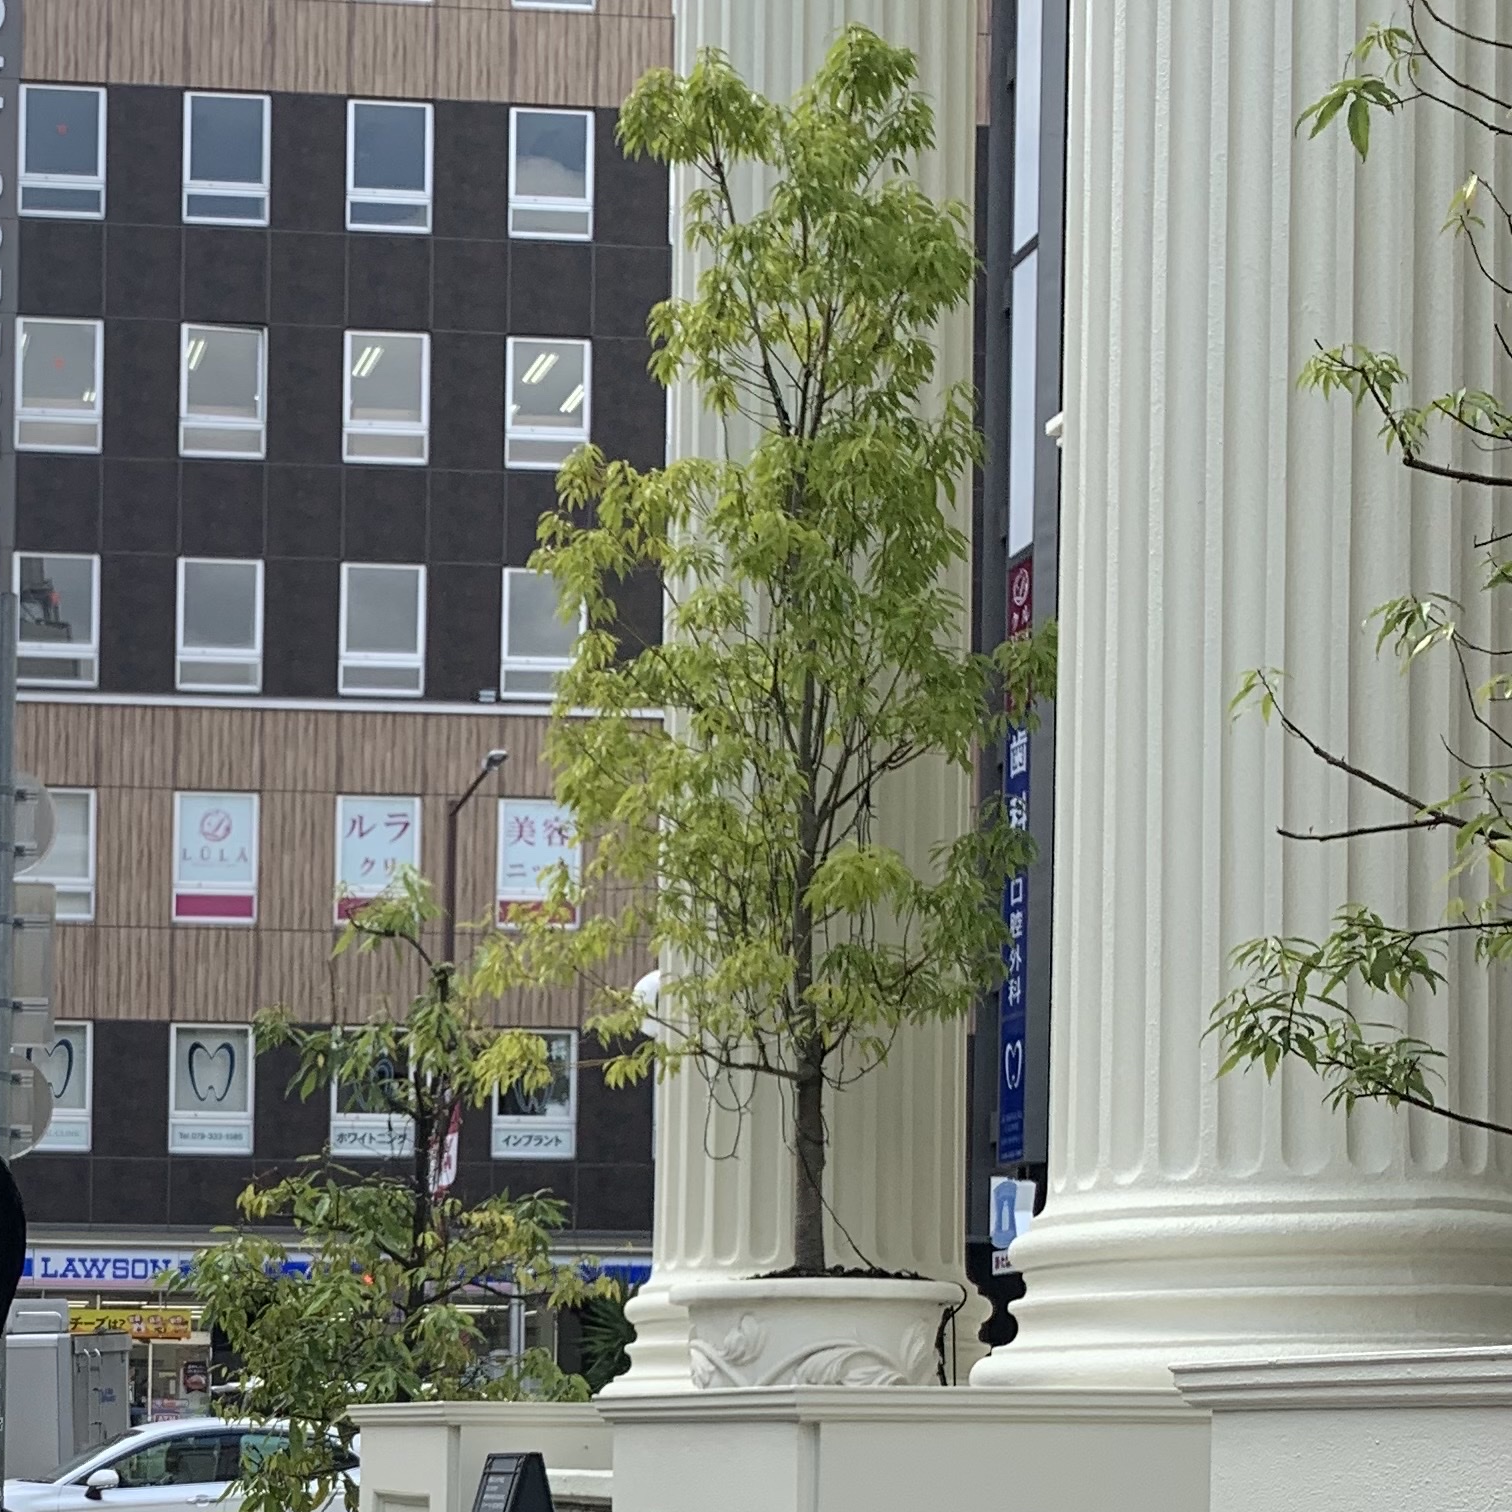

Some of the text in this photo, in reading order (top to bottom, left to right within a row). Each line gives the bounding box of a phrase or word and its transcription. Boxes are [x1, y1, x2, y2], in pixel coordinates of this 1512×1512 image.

[346, 813, 410, 843] ルラ
[507, 815, 570, 847] 美容
[502, 1134, 563, 1147] インプラント
[41, 1256, 172, 1279] LAWSON
